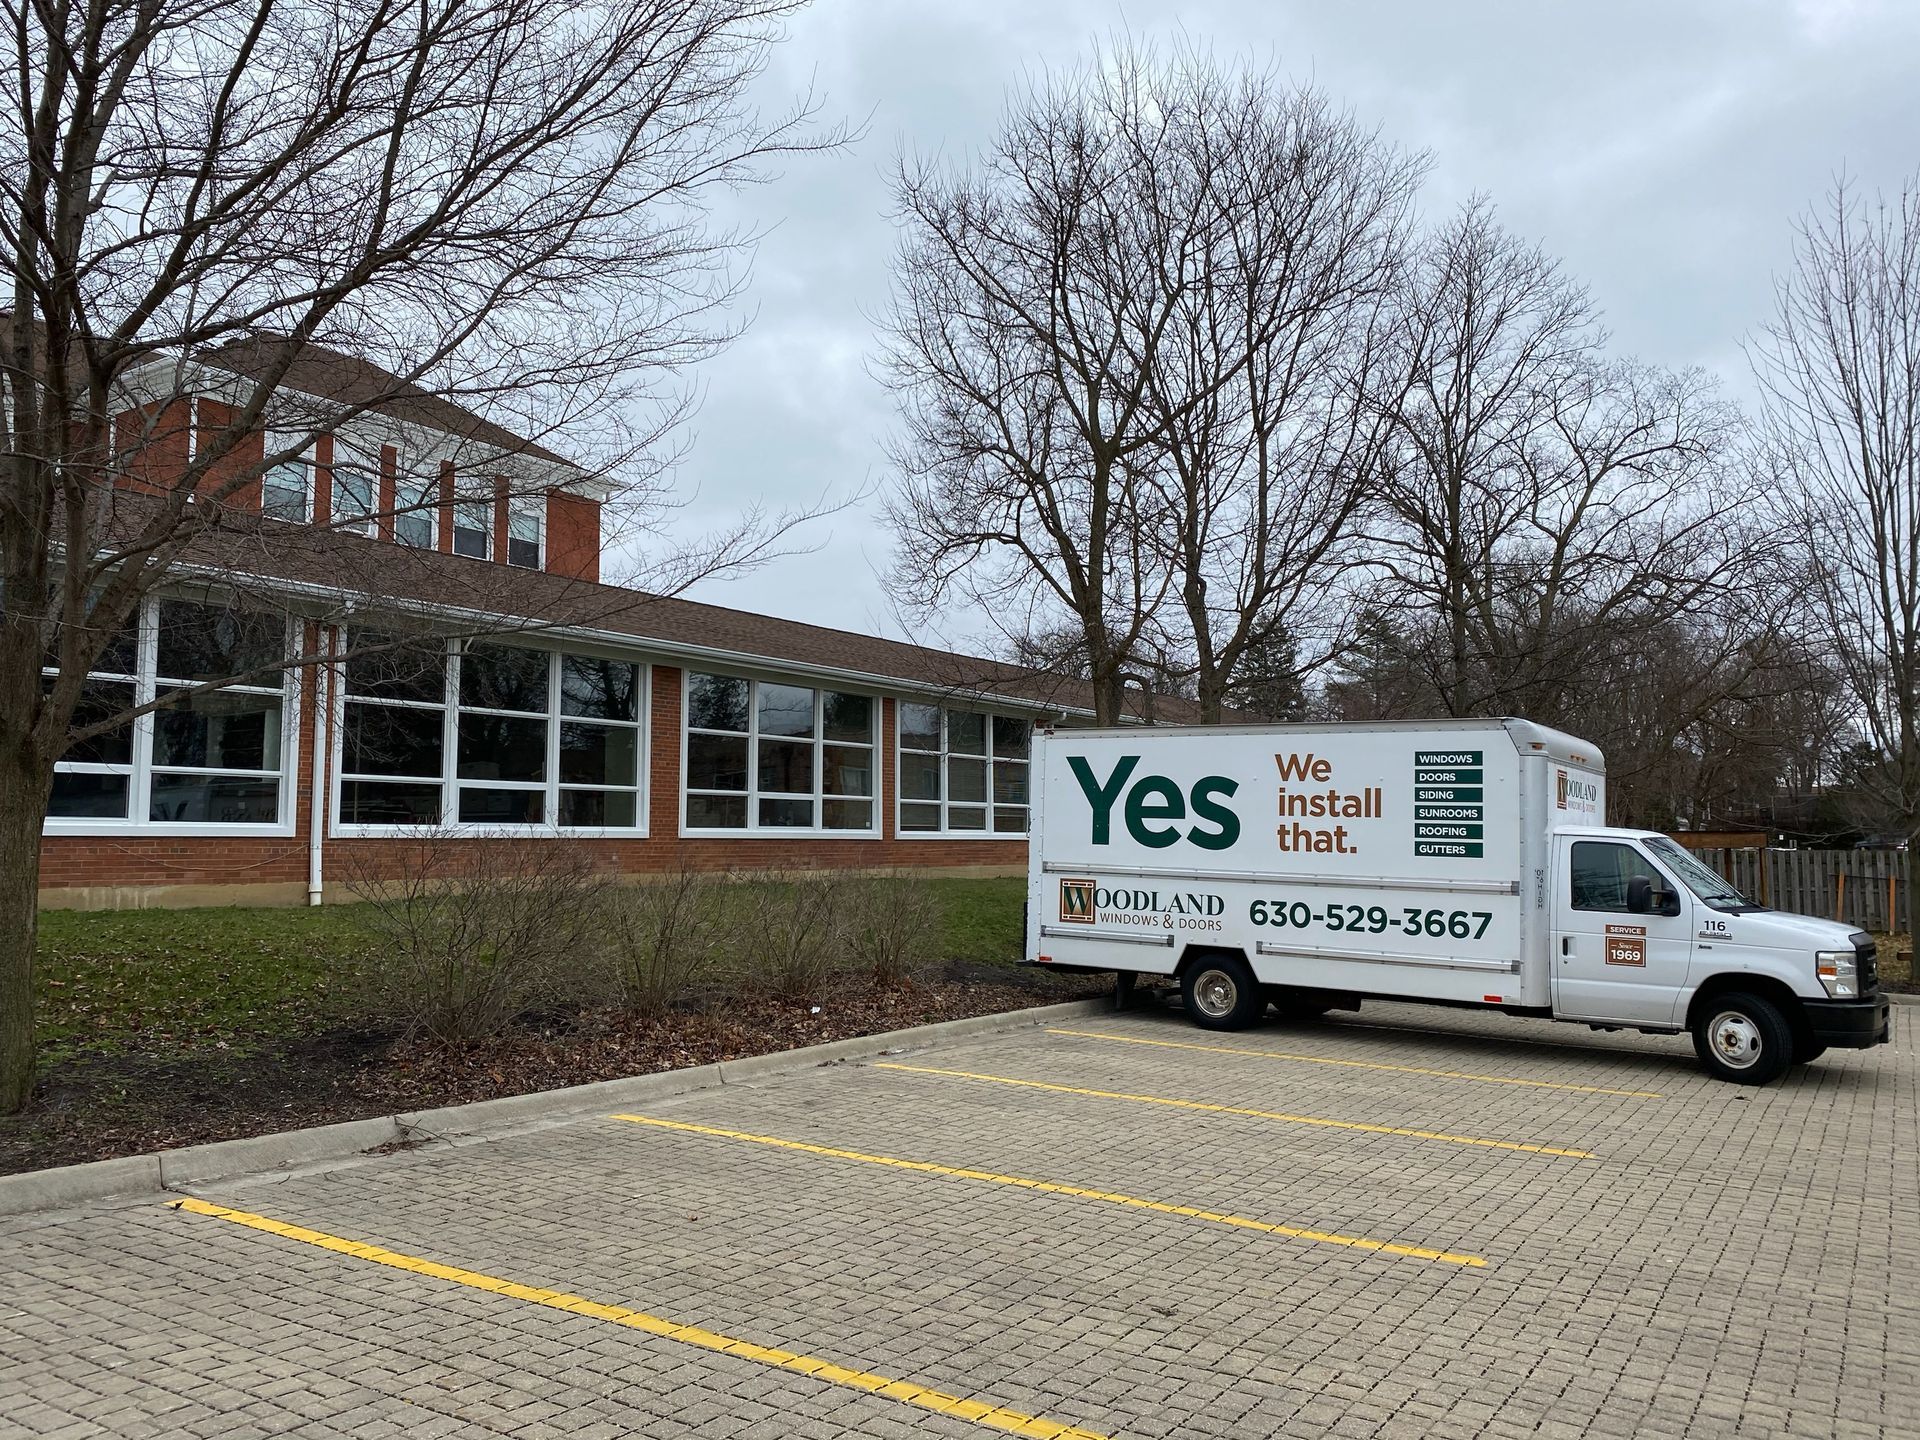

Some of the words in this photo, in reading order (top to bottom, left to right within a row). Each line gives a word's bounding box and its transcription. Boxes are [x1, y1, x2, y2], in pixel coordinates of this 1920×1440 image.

[1419, 754, 1473, 764] WINDOWS
[1275, 753, 1332, 782] We
[1419, 772, 1456, 782] DOORS
[1419, 790, 1454, 800] SIDING
[1066, 755, 1241, 851] Yes
[1278, 787, 1382, 818] install
[1419, 808, 1478, 818] SUNROOMS
[1419, 826, 1467, 836] ROOFING
[1277, 822, 1357, 854] that.
[1419, 844, 1466, 855] GUTTERS
[1063, 886, 1225, 916] WOODLAND
[1099, 912, 1159, 927] WINDOWS
[1162, 913, 1174, 930] &
[1178, 918, 1222, 932] DOORS
[1249, 899, 1493, 940] 630-529-3667
[1610, 926, 1642, 935] SERVICE
[1704, 920, 1726, 931] 116
[1611, 949, 1641, 961] 1969
